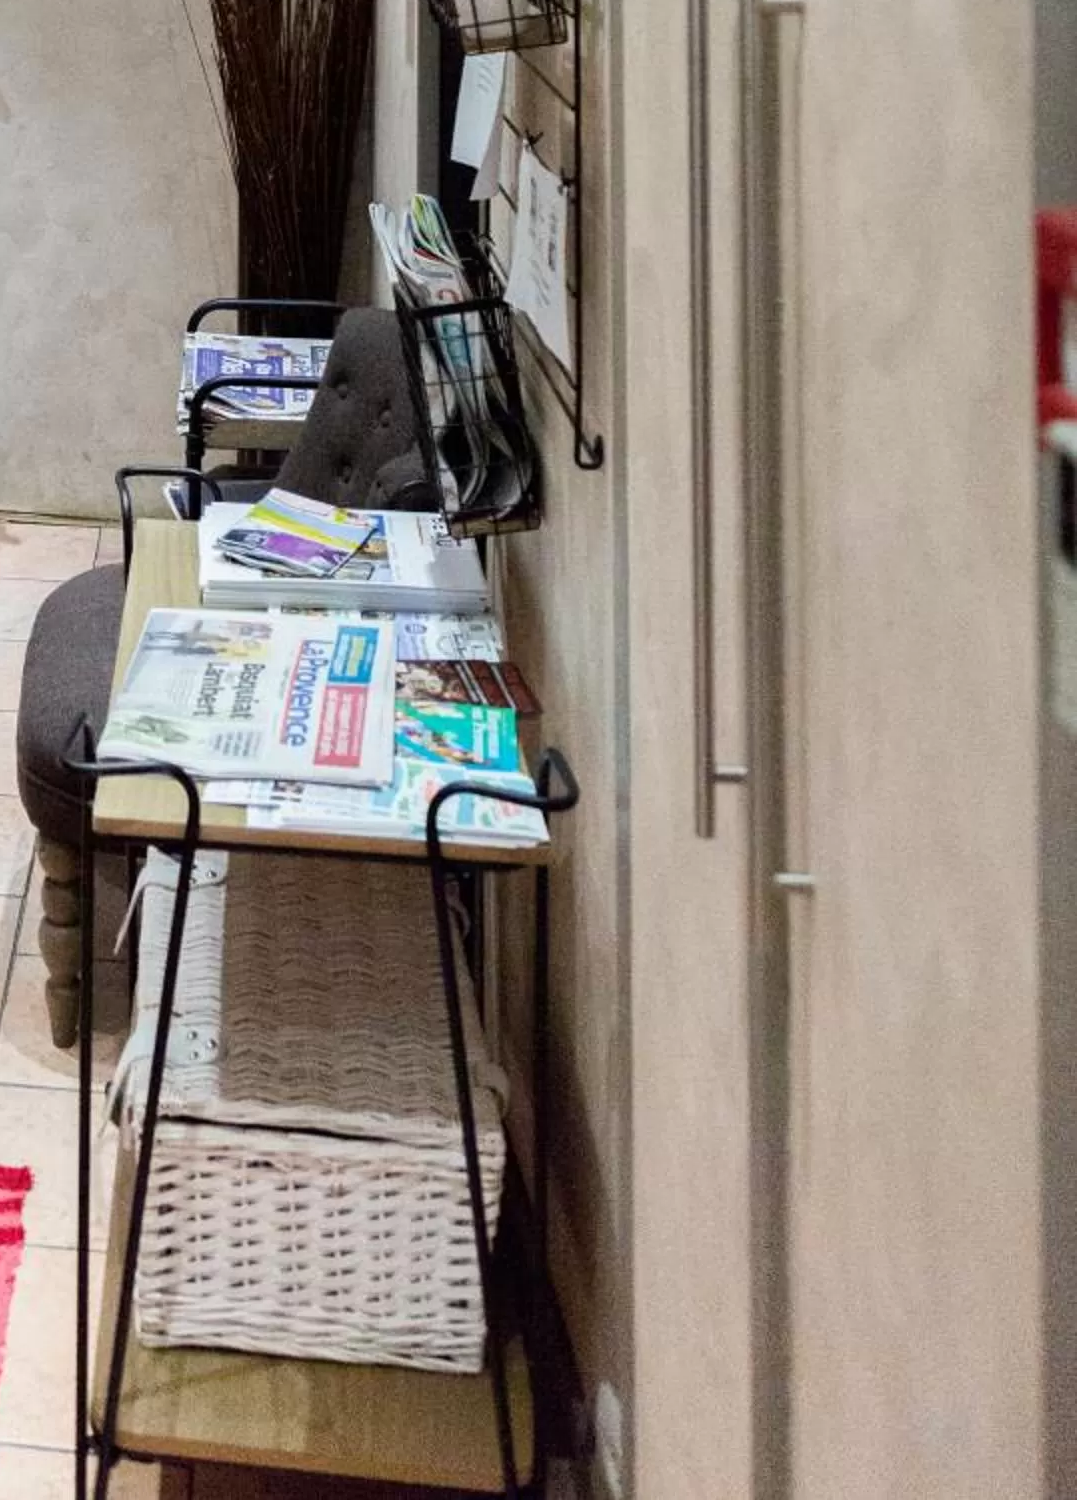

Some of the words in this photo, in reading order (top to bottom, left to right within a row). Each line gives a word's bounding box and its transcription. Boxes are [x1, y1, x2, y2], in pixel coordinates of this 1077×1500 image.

[193, 661, 230, 716] Lambert
[230, 663, 266, 719] Basquiat
[286, 657, 330, 747] Provence
